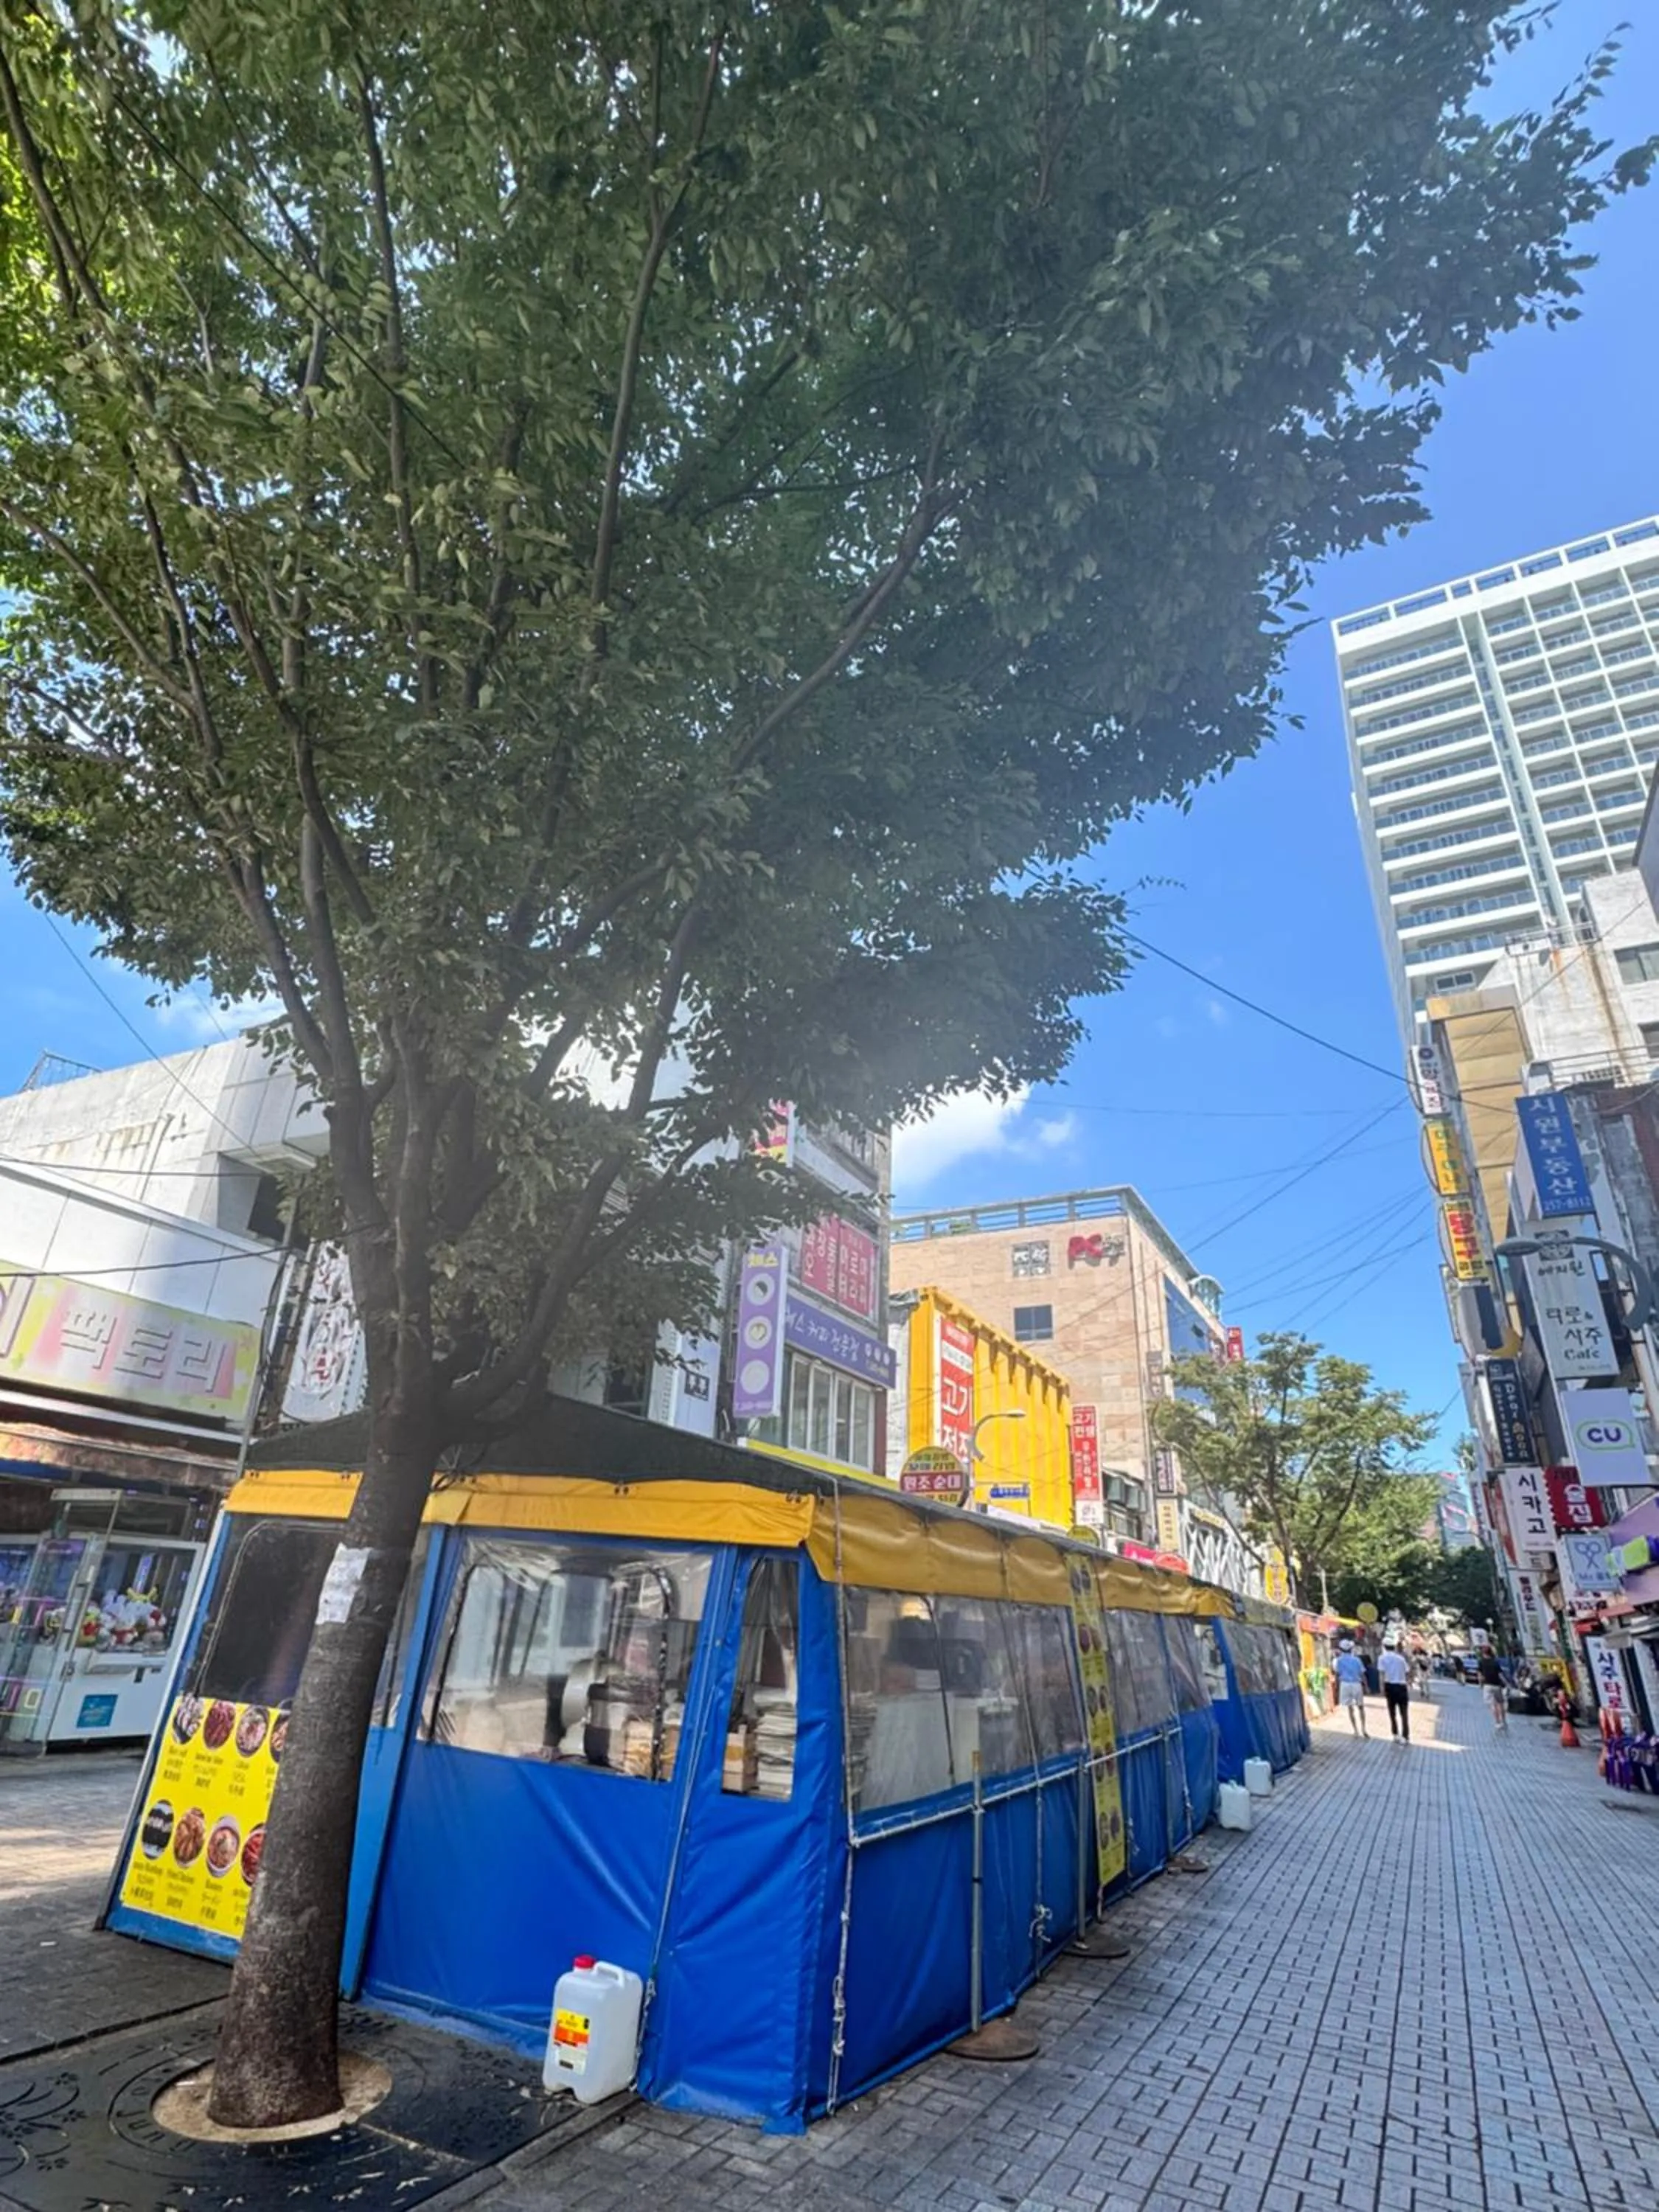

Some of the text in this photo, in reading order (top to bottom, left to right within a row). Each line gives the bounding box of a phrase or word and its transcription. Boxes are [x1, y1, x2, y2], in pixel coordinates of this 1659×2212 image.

[1528, 1096, 1579, 1197] 시원부동산
[60, 1311, 229, 1393] 팩토리
[1564, 1327, 1604, 1346] 사주
[942, 1377, 973, 1428] 고기
[1586, 1426, 1622, 1444] CU
[1518, 1472, 1547, 1534] 시카고
[1564, 1484, 1593, 1524] 술집
